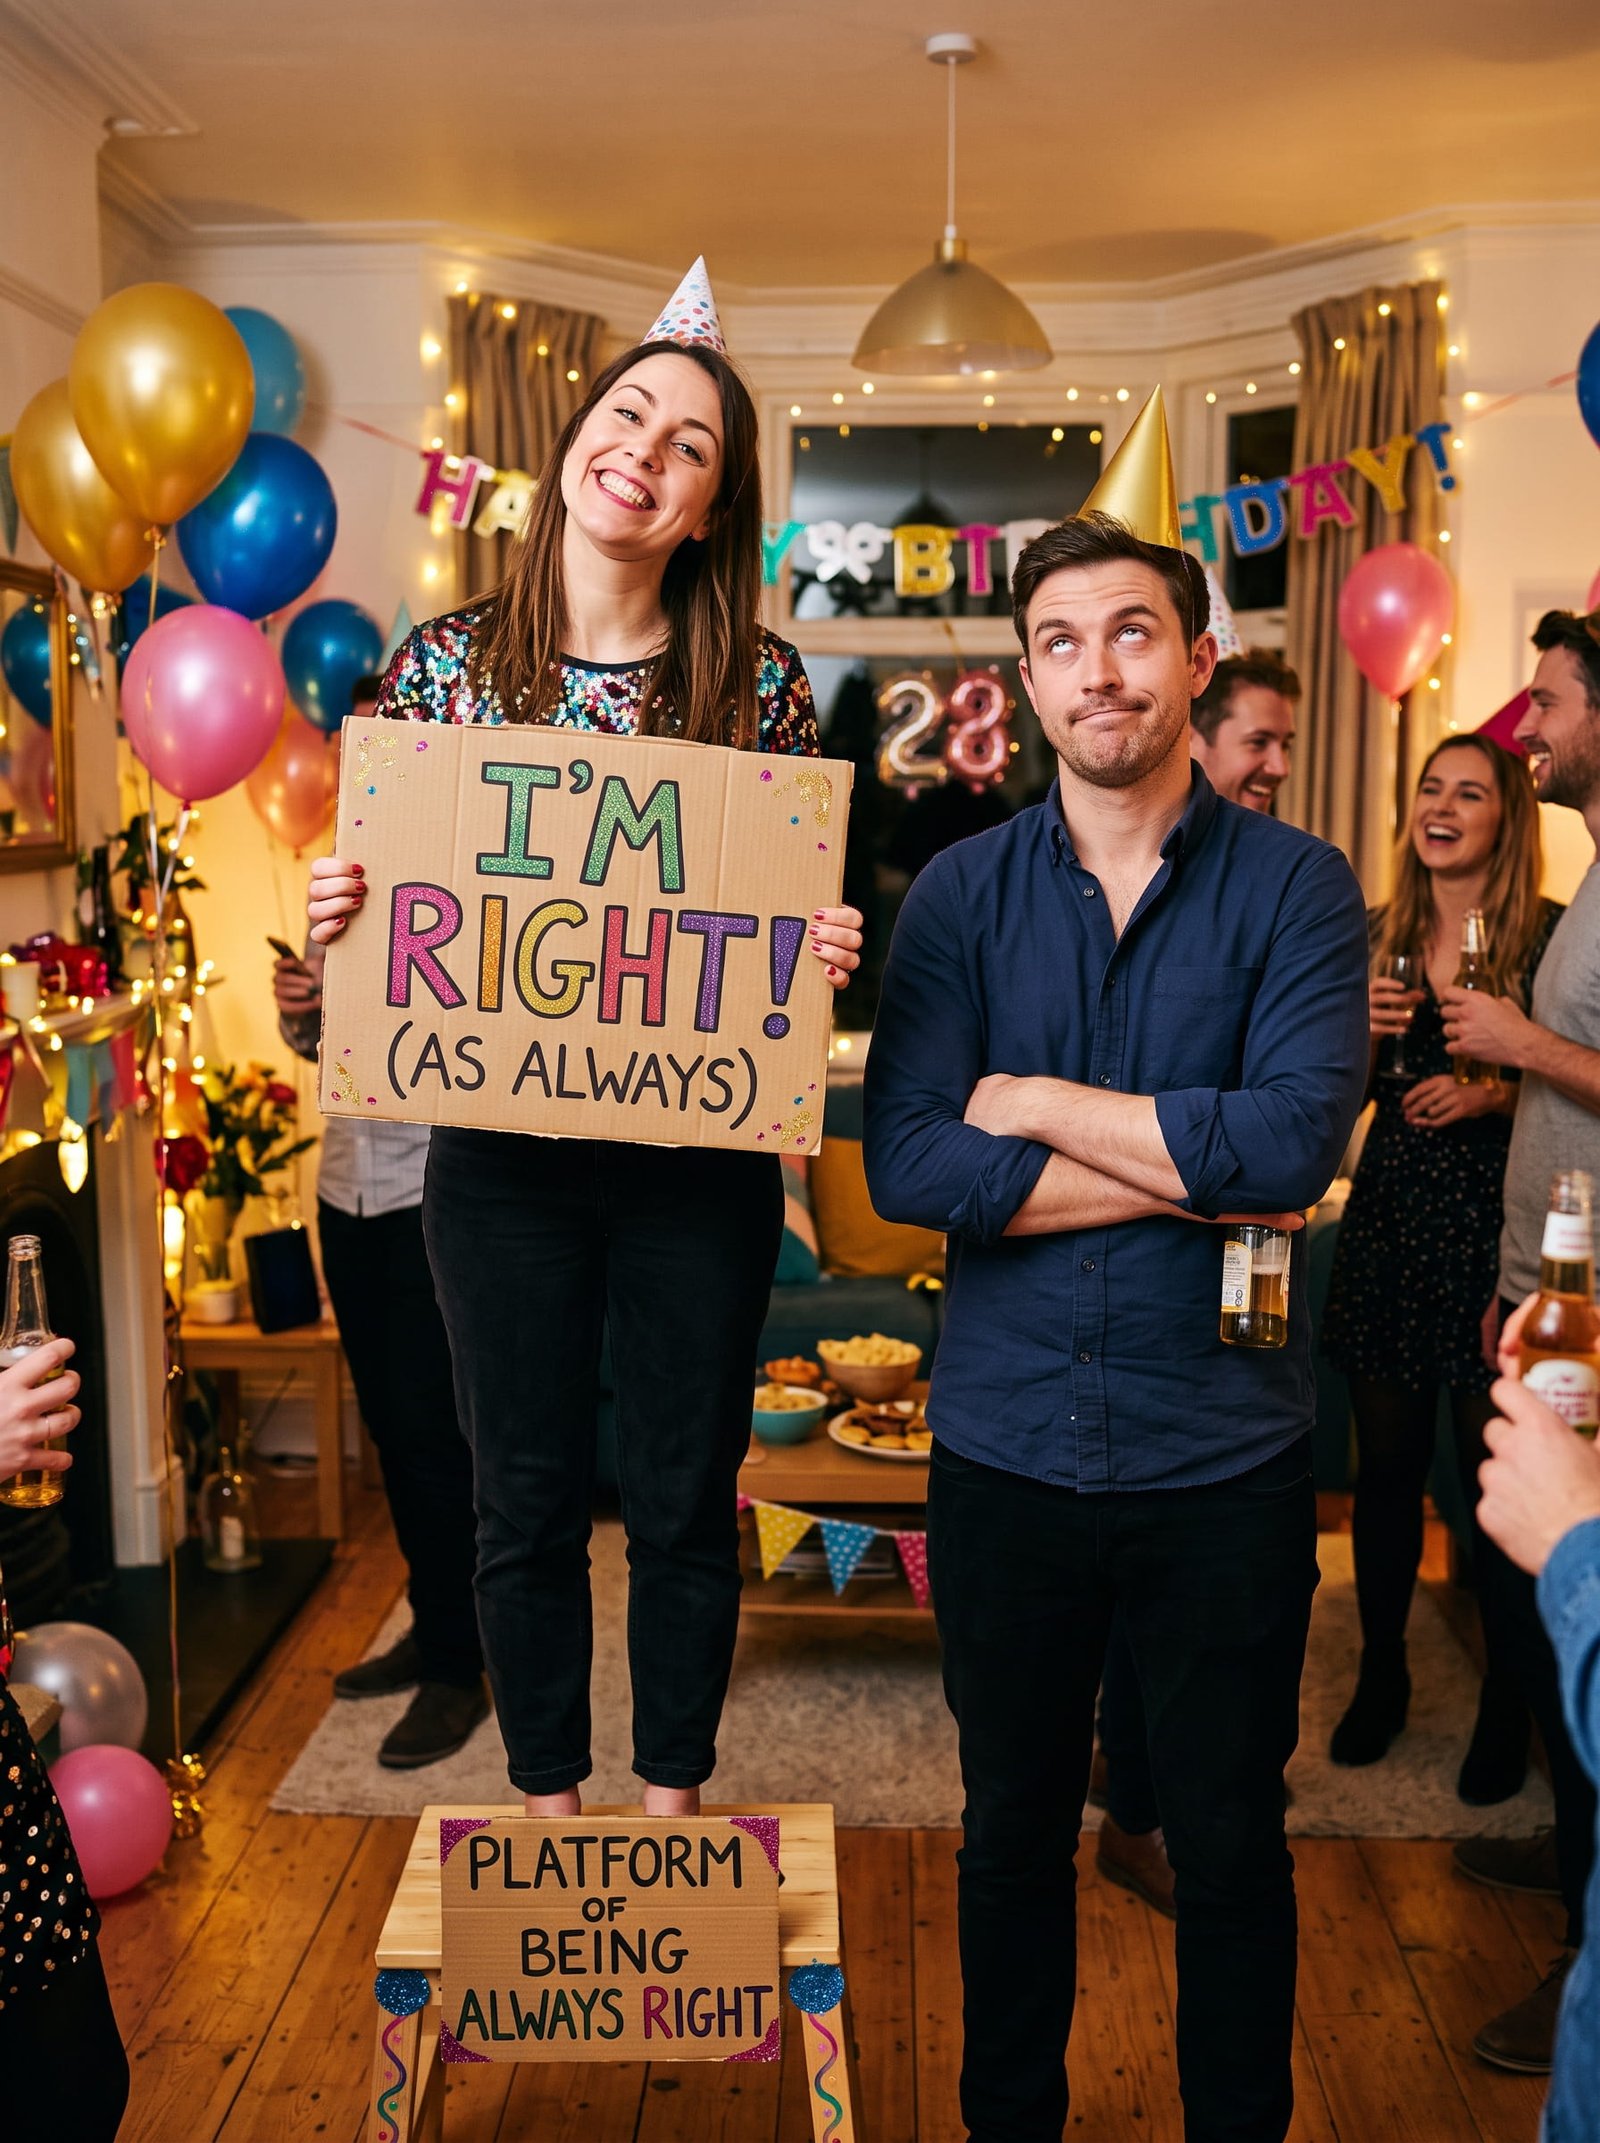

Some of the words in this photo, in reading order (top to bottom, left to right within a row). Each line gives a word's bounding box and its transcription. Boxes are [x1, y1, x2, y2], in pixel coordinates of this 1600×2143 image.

[875, 670, 1013, 790] 28
[477, 760, 685, 893] I'M
[386, 882, 807, 1039] RIGHT!
[387, 1020, 486, 1100] (AS
[511, 1040, 758, 1130] ALWAYS)
[469, 1835, 742, 1890] PLATFORM
[581, 1896, 627, 1922] OF
[521, 1927, 689, 1977] BEING
[456, 1988, 624, 2041] ALWAYS
[643, 1986, 774, 2040] RIGHT
